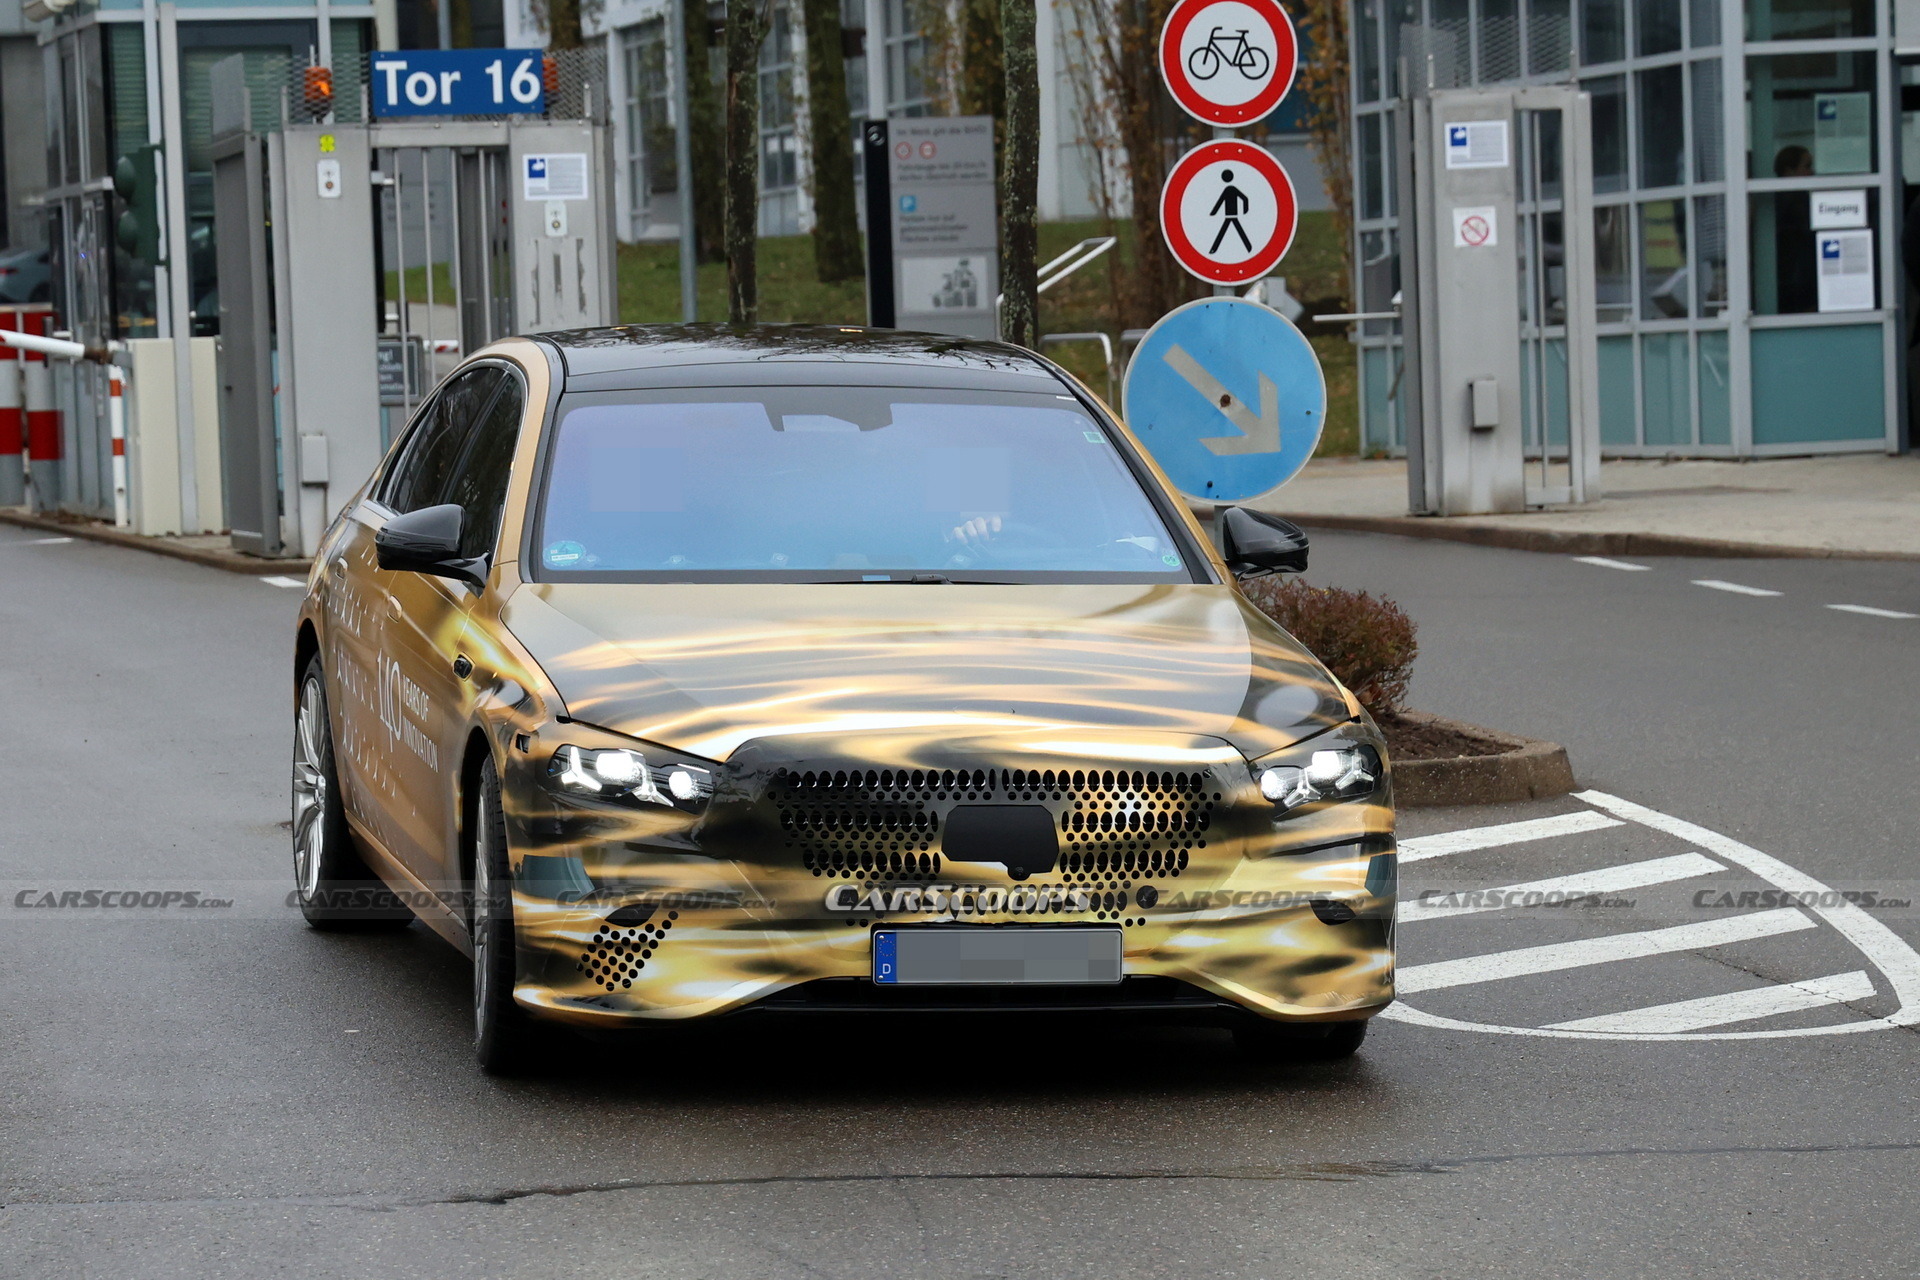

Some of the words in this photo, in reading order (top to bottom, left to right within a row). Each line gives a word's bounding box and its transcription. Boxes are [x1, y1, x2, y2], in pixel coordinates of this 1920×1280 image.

[375, 60, 461, 106] Tor
[485, 58, 541, 104] 16
[1818, 202, 1859, 216] Eingang
[402, 673, 420, 716] YEARS
[420, 690, 430, 723] OF
[402, 714, 439, 774] INNOVATION
[882, 963, 891, 975] D
